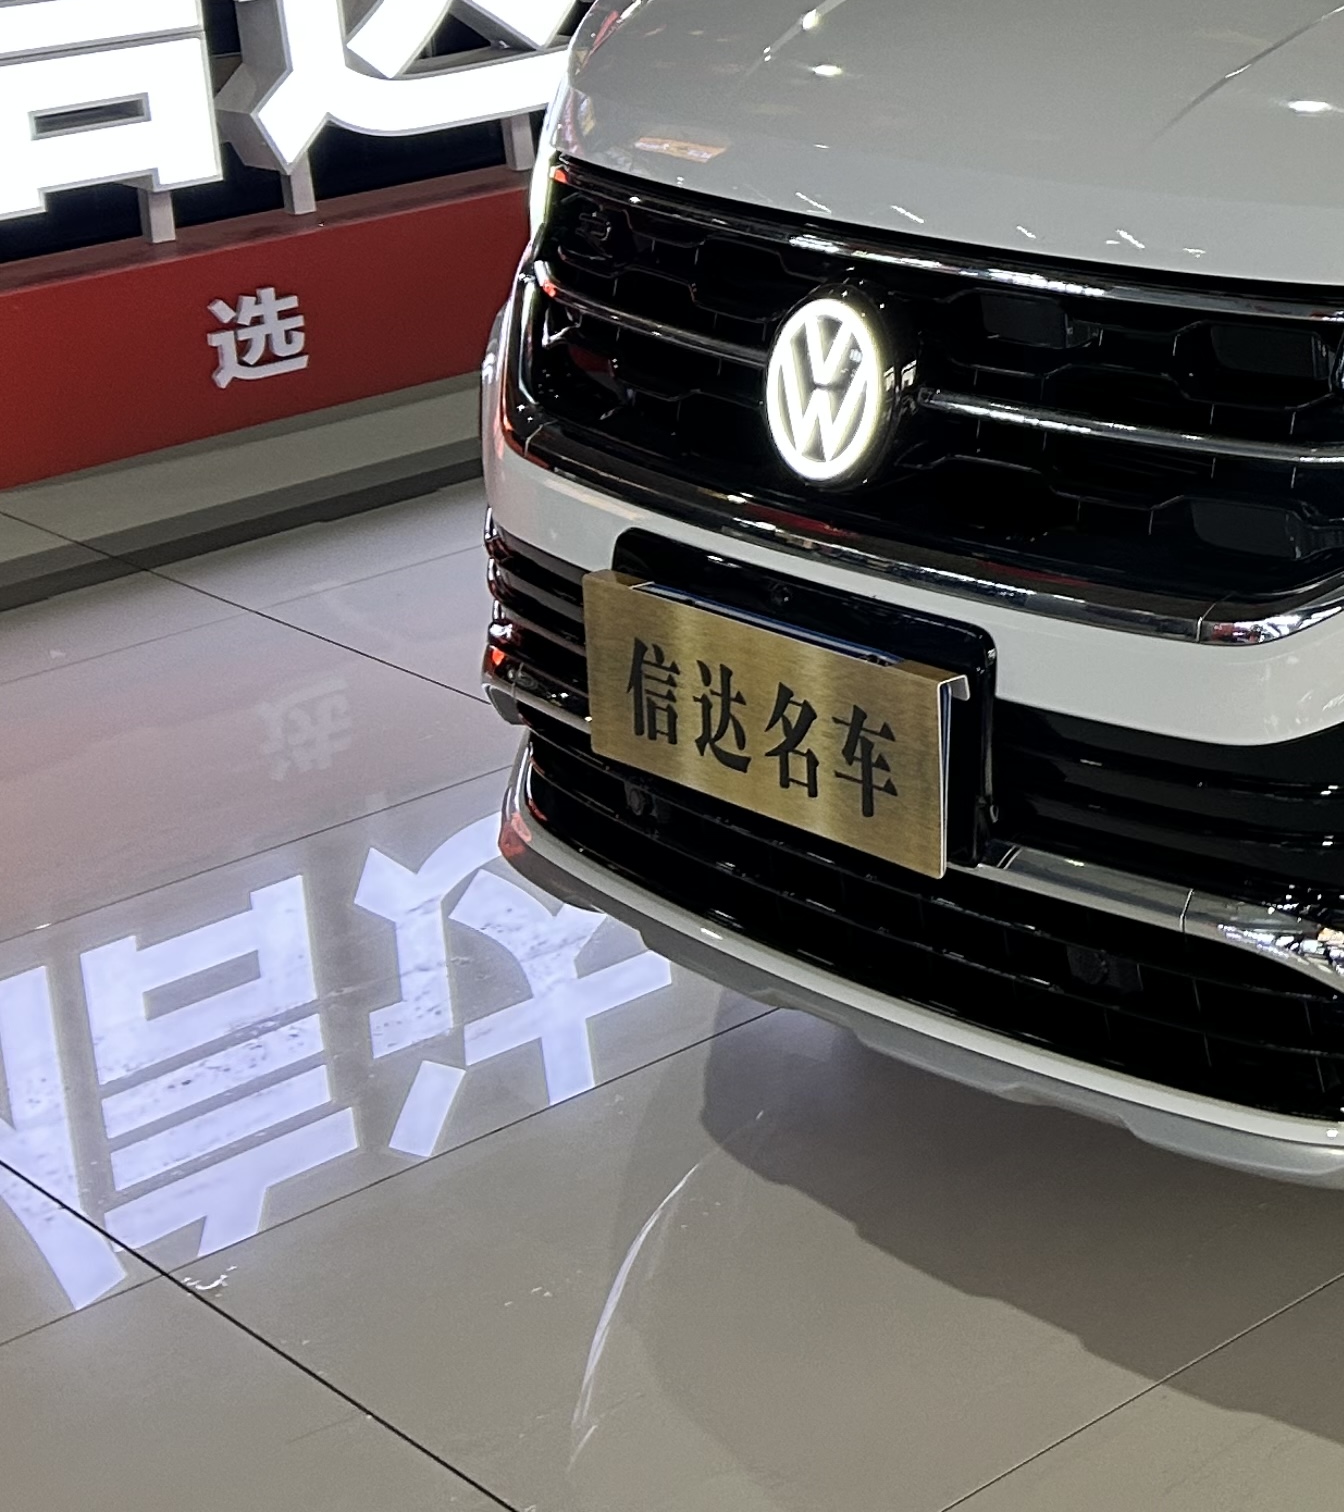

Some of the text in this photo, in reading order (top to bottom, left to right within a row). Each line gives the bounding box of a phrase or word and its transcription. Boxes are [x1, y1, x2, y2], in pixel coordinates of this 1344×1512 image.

[205, 286, 310, 388] 选
[626, 636, 899, 819] 信达名车
